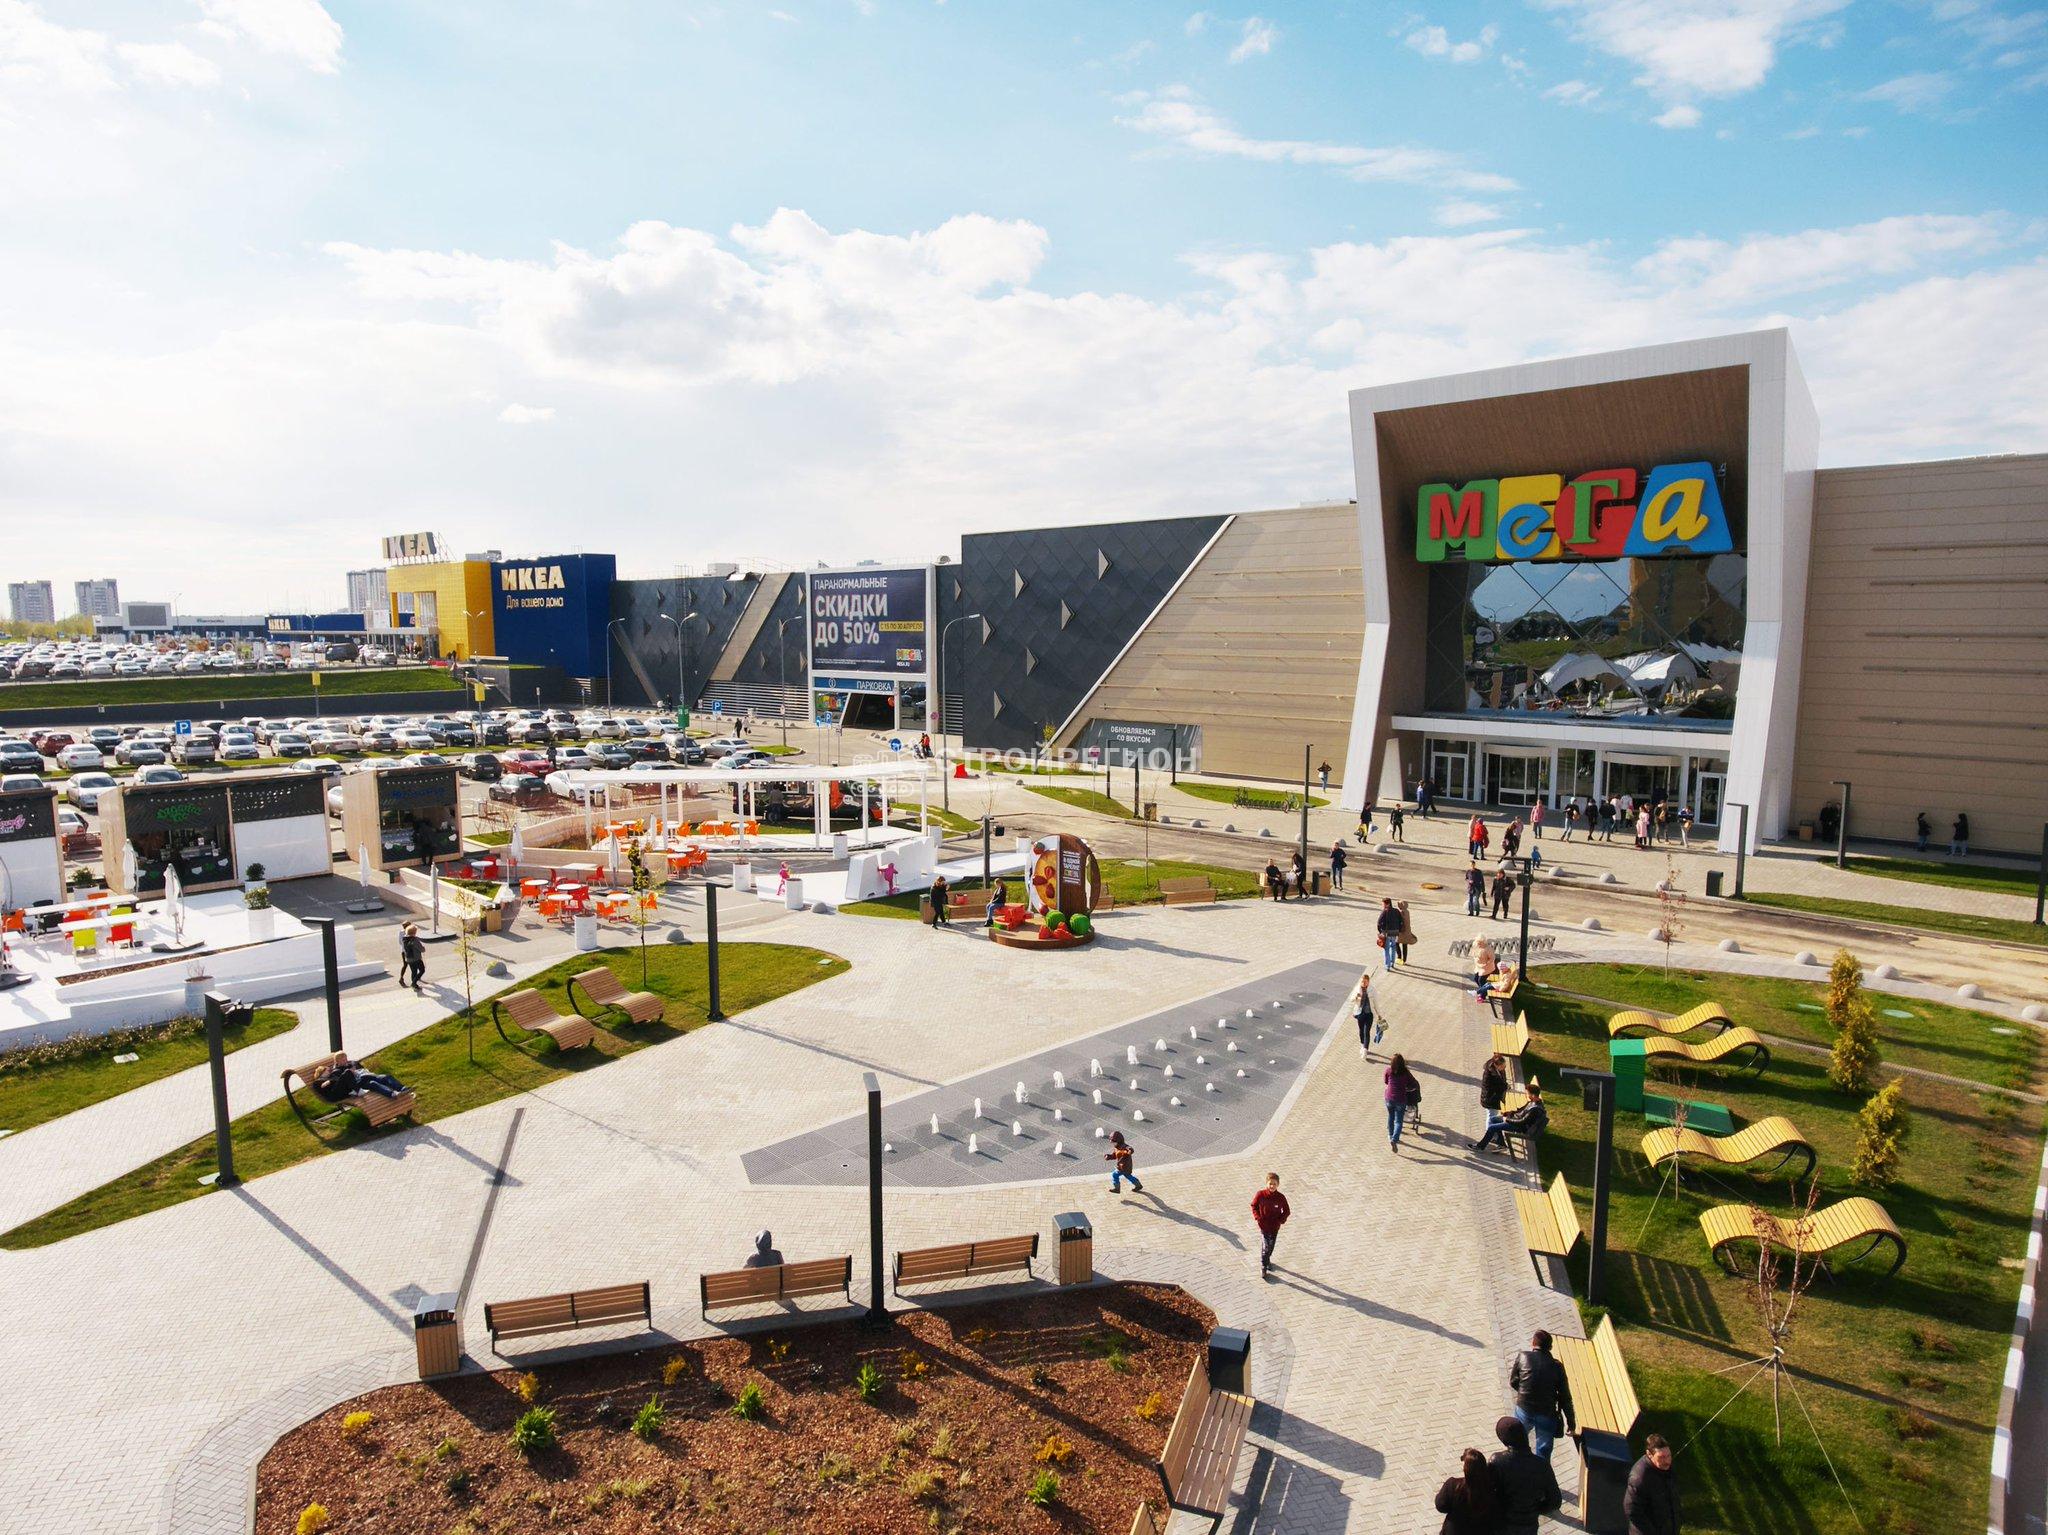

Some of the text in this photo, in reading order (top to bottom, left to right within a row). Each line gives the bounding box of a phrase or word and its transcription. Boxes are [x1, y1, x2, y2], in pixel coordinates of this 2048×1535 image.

[382, 532, 434, 558] IKEA
[501, 565, 565, 591] ИКЕА
[814, 577, 888, 590] ПАРАНОРМАЛЬНЫЕ
[506, 595, 520, 609] Для
[815, 594, 888, 621] СКИДКИ
[815, 621, 880, 647] ДО 50%
[856, 681, 892, 691] ПАРКОВКА
[1110, 726, 1156, 736] ОБНОВЛЯЕМСЯ
[1125, 735, 1151, 744] ВКУСОМ
